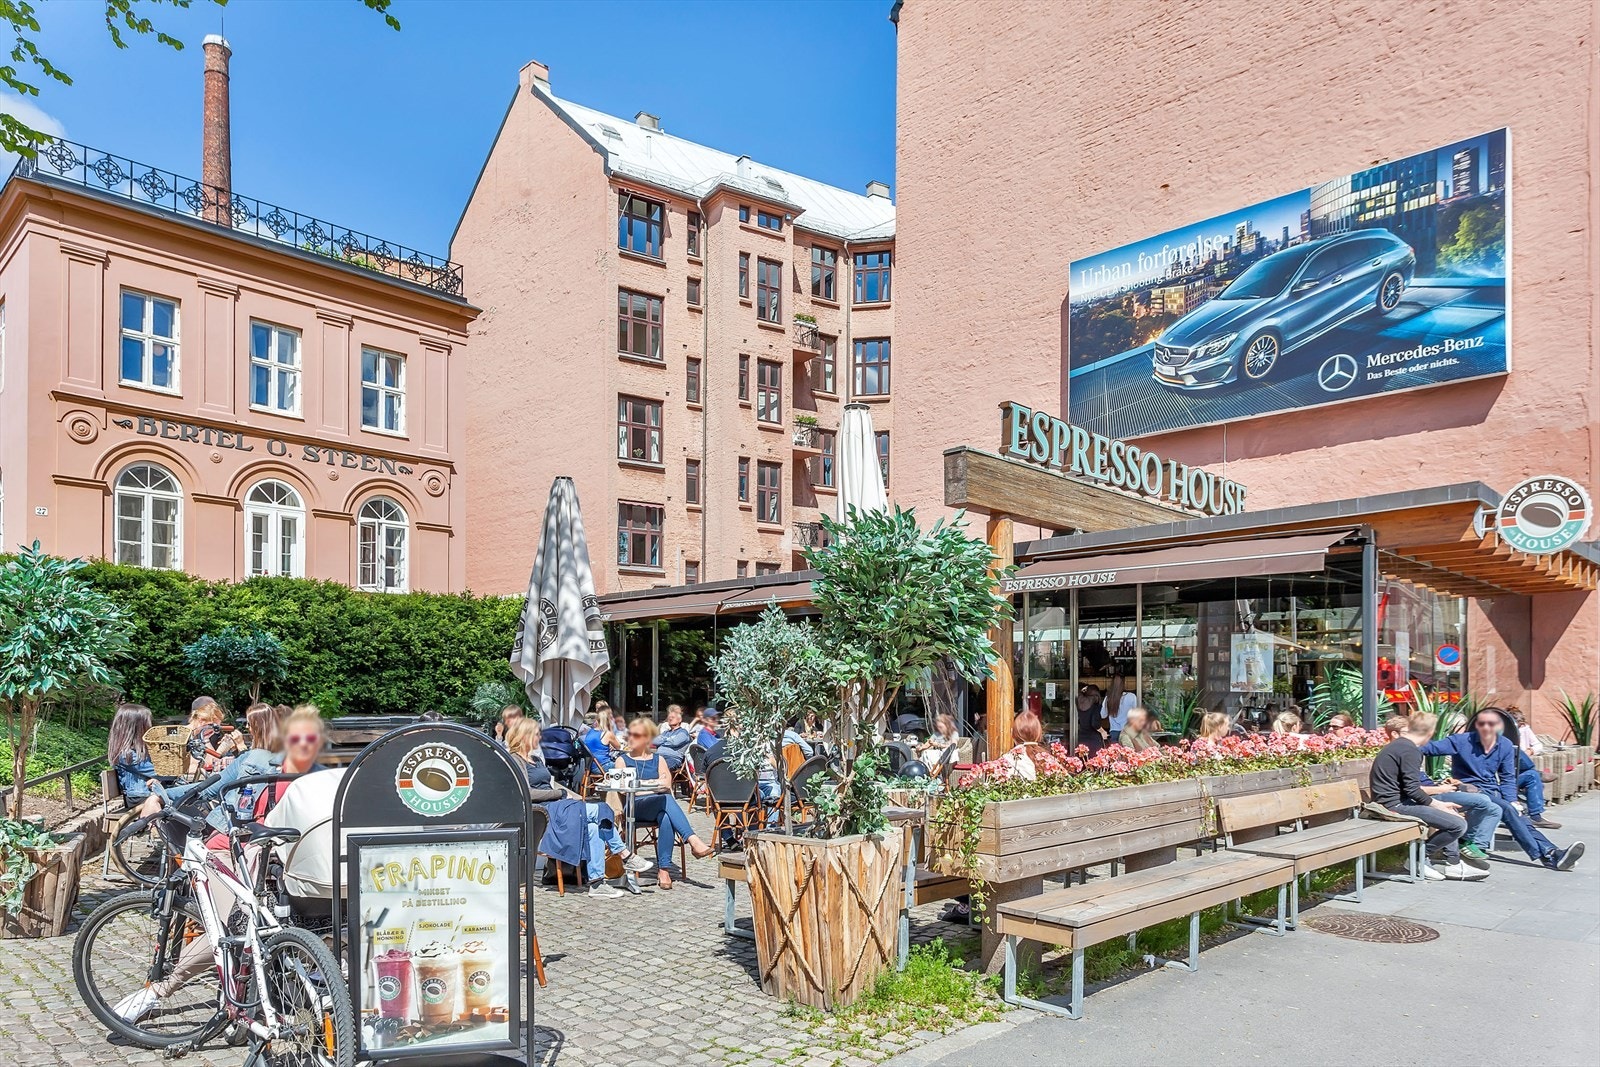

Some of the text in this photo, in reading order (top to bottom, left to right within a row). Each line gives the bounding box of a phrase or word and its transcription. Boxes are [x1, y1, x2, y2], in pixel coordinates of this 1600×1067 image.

[1080, 262, 1132, 289] Urban
[1121, 275, 1163, 292] Shooting
[1165, 265, 1194, 280] Brake
[1366, 336, 1485, 368] Mercedes-Benz
[1366, 357, 1460, 381] Das Beste oder nichts.
[136, 415, 398, 476] BERTEL O. STEEN
[1009, 402, 1248, 516] ESPRESSO HOUSE
[1504, 480, 1582, 513] ESPRESSO
[36, 507, 47, 515] 27
[1512, 528, 1574, 549] HOUSE
[1004, 572, 1117, 592] ESPRESSO HOUSE
[401, 747, 467, 775] ESPRESSO
[409, 794, 460, 812] HOUSE
[370, 854, 497, 893] FRAPINO
[401, 897, 468, 908] PÅ BESTILLING
[418, 888, 451, 896] MIKSET
